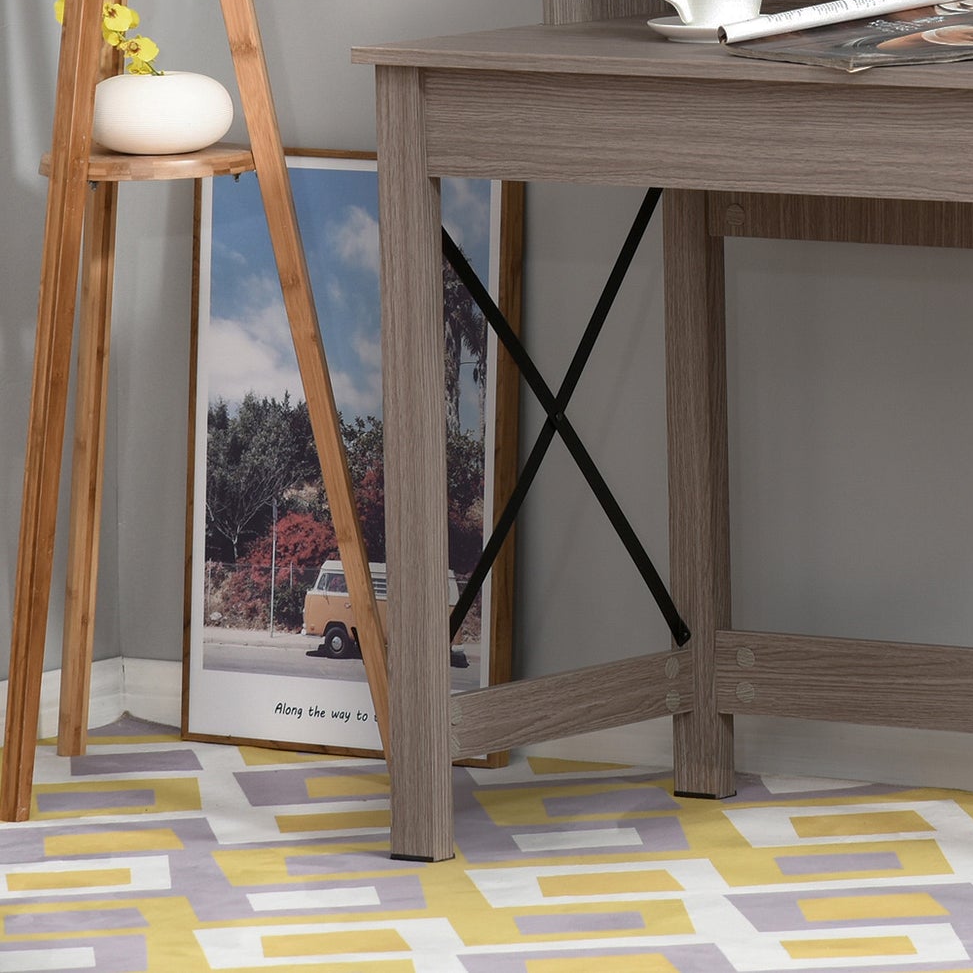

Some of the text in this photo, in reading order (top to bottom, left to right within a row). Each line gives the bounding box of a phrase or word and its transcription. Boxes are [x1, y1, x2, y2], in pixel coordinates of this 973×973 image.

[274, 702, 303, 719] Along
[308, 705, 326, 718] the
[331, 710, 351, 723] way
[356, 710, 369, 722] to
